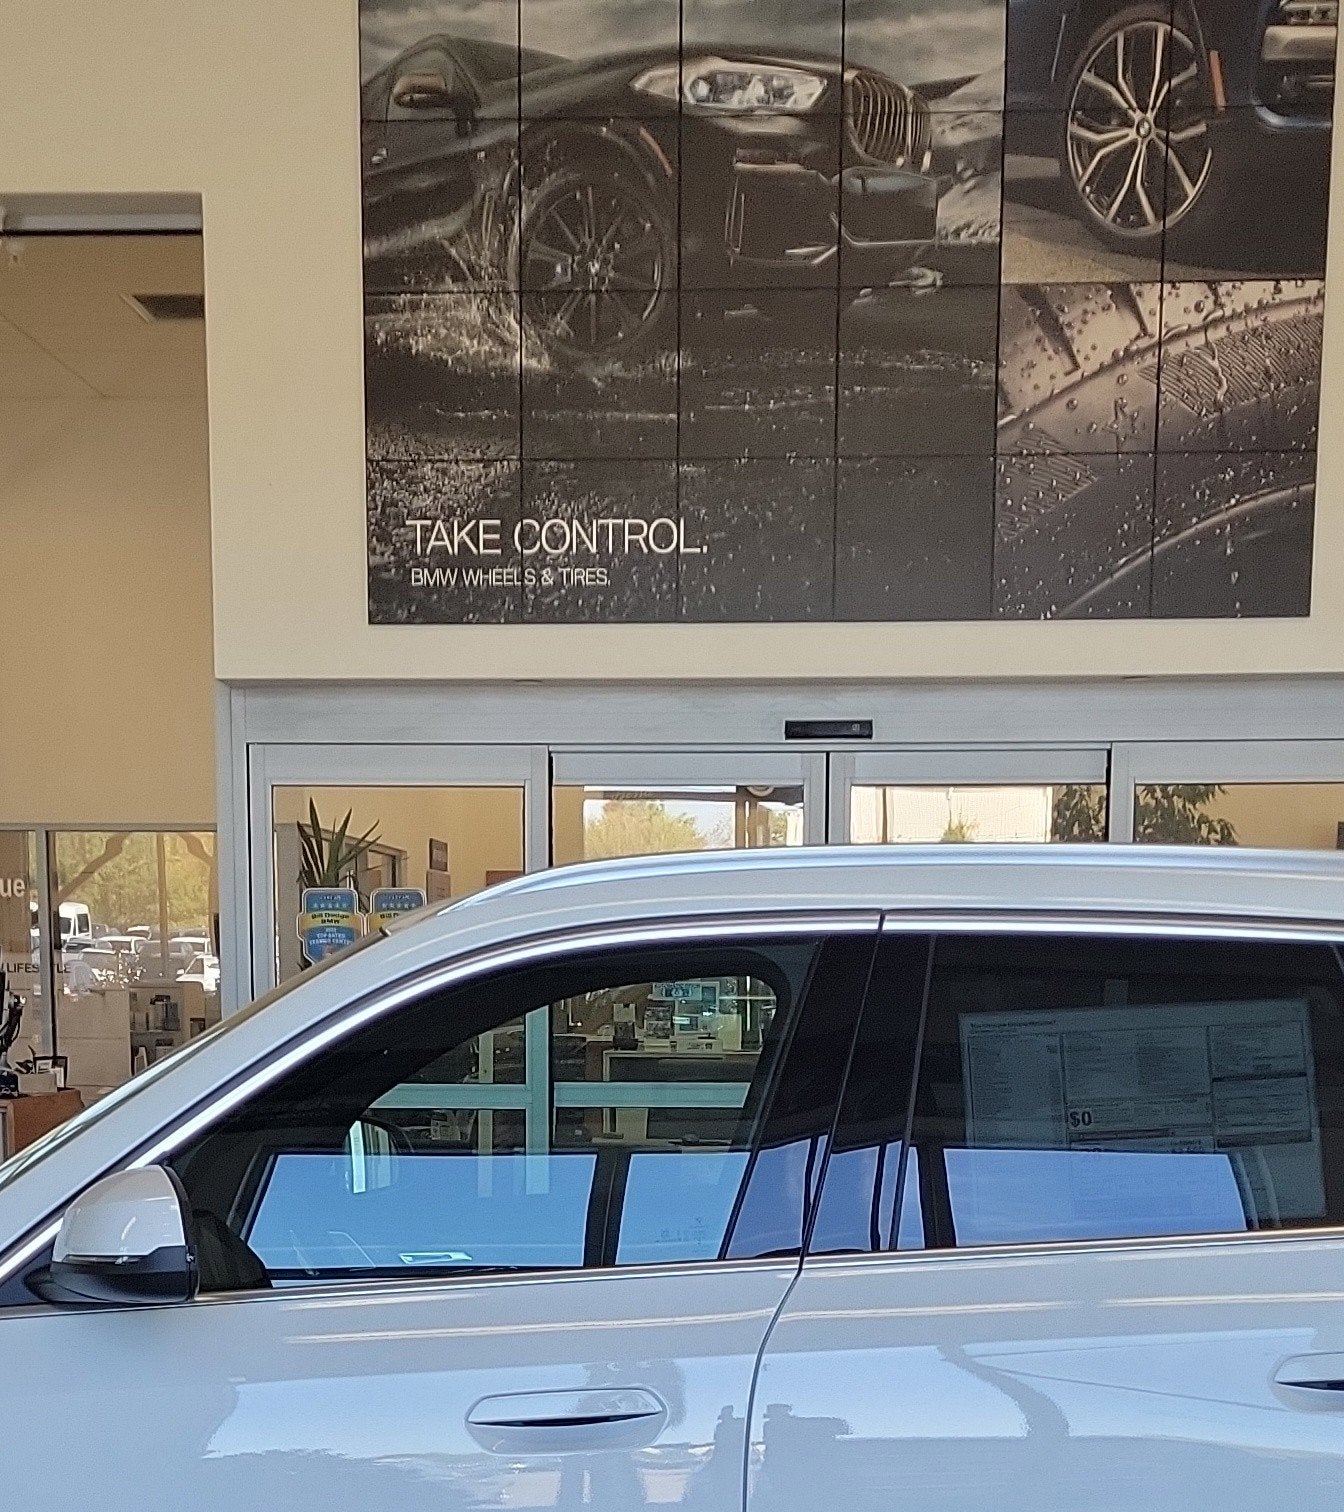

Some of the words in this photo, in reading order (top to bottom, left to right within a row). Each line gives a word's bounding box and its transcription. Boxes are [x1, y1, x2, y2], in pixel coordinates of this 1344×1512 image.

[406, 518, 502, 556] TAKE
[514, 517, 709, 556] CONTROL.
[411, 567, 458, 587] BMW
[462, 567, 537, 587] WHEELS
[540, 567, 555, 587] &
[560, 567, 612, 587] TIRES.
[5, 962, 71, 974] LIFESLE
